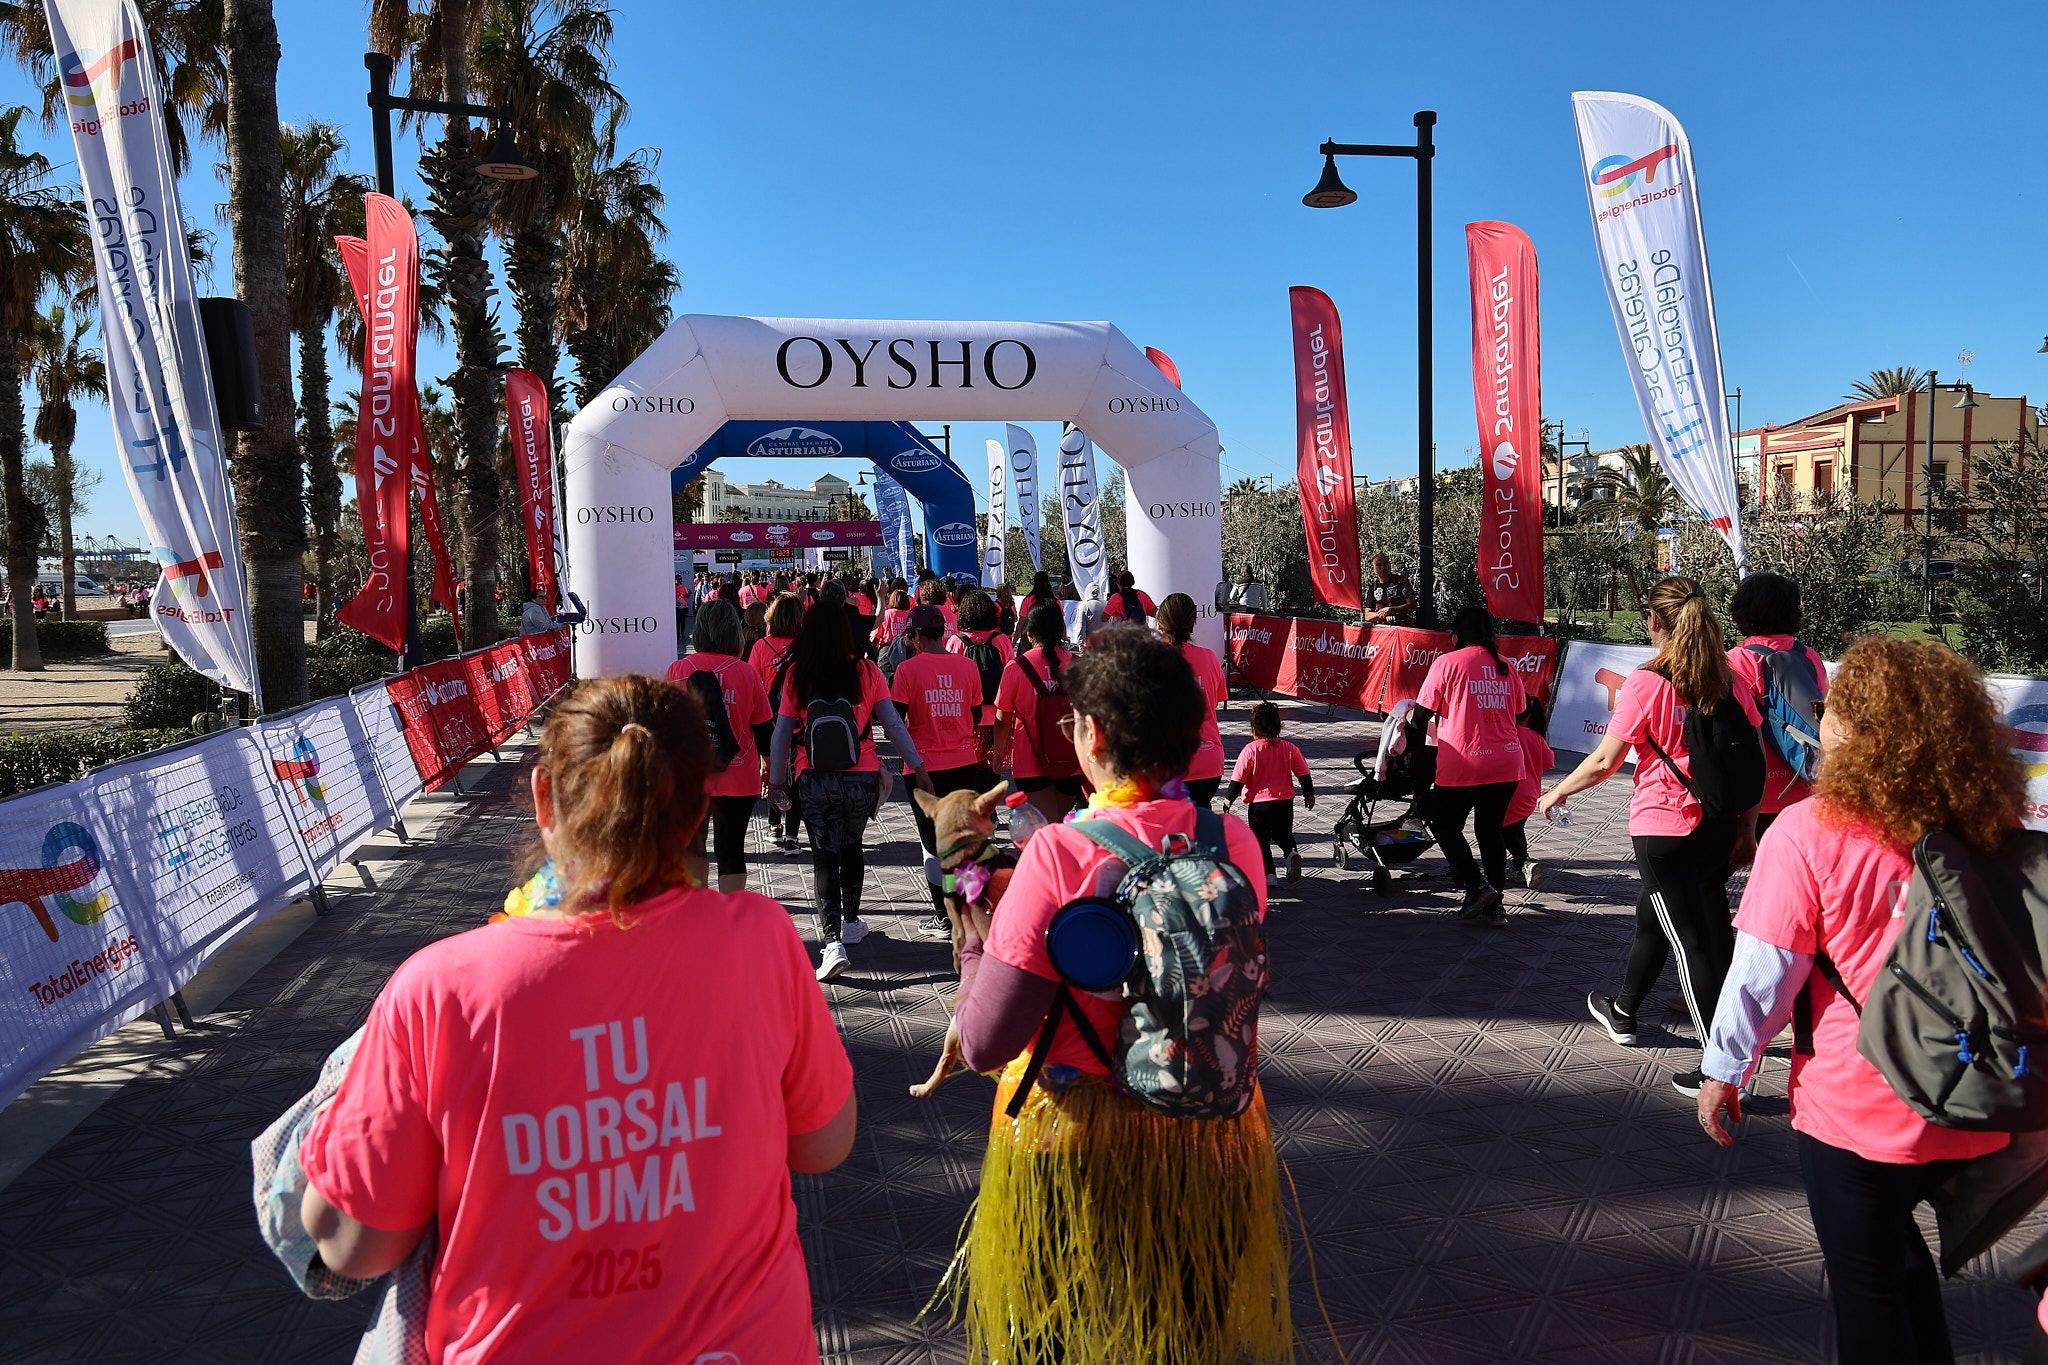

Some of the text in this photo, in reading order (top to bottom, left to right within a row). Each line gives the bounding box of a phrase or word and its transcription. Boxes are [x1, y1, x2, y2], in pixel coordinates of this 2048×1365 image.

[776, 336, 1037, 390] OYSHO
[612, 396, 695, 414] OYSHO
[1108, 397, 1180, 414] OYSHO
[577, 506, 654, 525] OYSHO
[1149, 502, 1216, 519] OYSHO
[581, 616, 657, 635] OYSHO
[1233, 626, 1272, 644] Santander
[1288, 631, 1380, 659] Sports Santander
[937, 675, 952, 688] TU
[1481, 665, 1496, 679] TU
[925, 689, 964, 703] DORSAL
[1470, 680, 1511, 694] DORSAL
[931, 703, 961, 717] SUMA
[1476, 695, 1507, 709] SUMA
[196, 819, 258, 869] LasCarreras
[206, 868, 257, 905] totalenergies.es
[28, 934, 140, 1010] TotalEnergies
[570, 1015, 649, 1092] TU
[502, 1077, 721, 1175] DORSAL
[537, 1151, 695, 1242] SUMA
[569, 1243, 662, 1299] 2025
